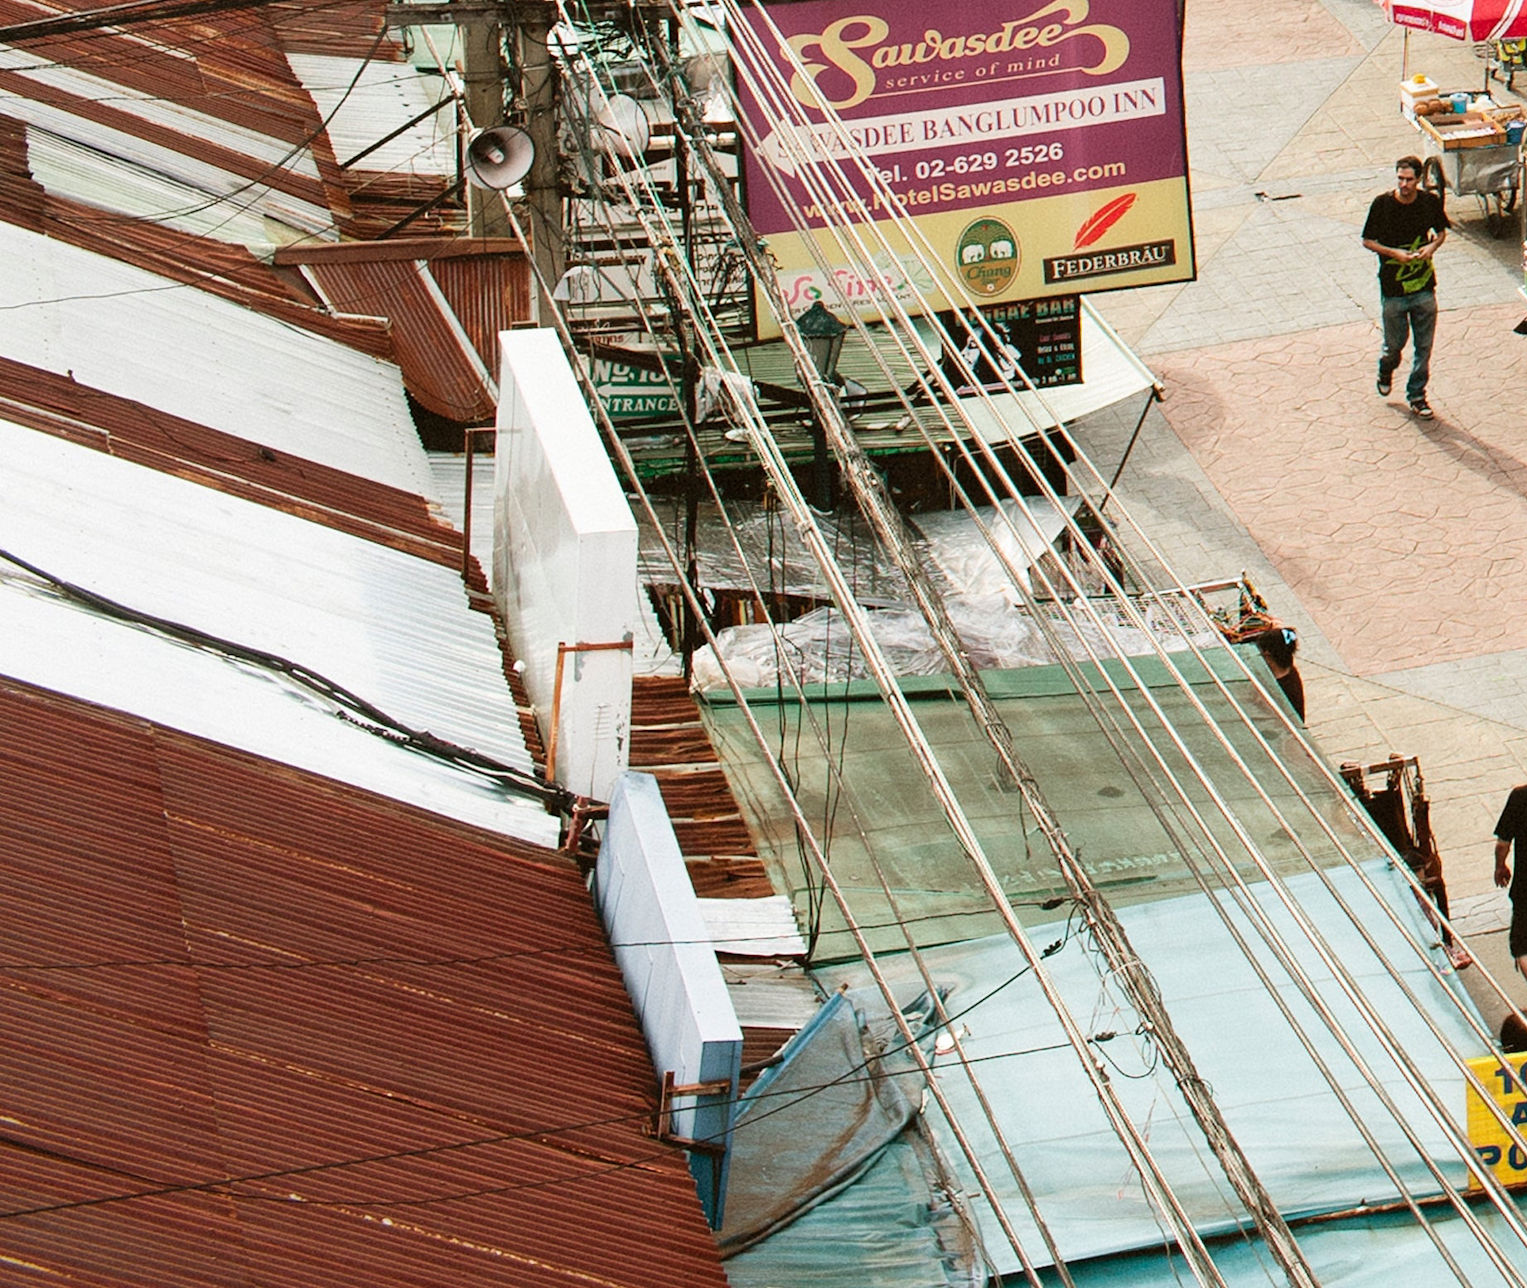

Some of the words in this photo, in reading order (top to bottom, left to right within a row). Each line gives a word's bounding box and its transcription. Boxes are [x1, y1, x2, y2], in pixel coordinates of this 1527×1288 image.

[885, 67, 966, 90] service
[975, 61, 998, 78] of
[1007, 53, 1061, 75] mind
[922, 96, 1106, 142] BANGLUMPOO
[1113, 87, 1159, 115] INN
[916, 150, 999, 182] 02-629
[1005, 142, 1065, 170] 2526
[1050, 245, 1167, 279] FEDERBRÄU
[1036, 297, 1077, 317] BAR
